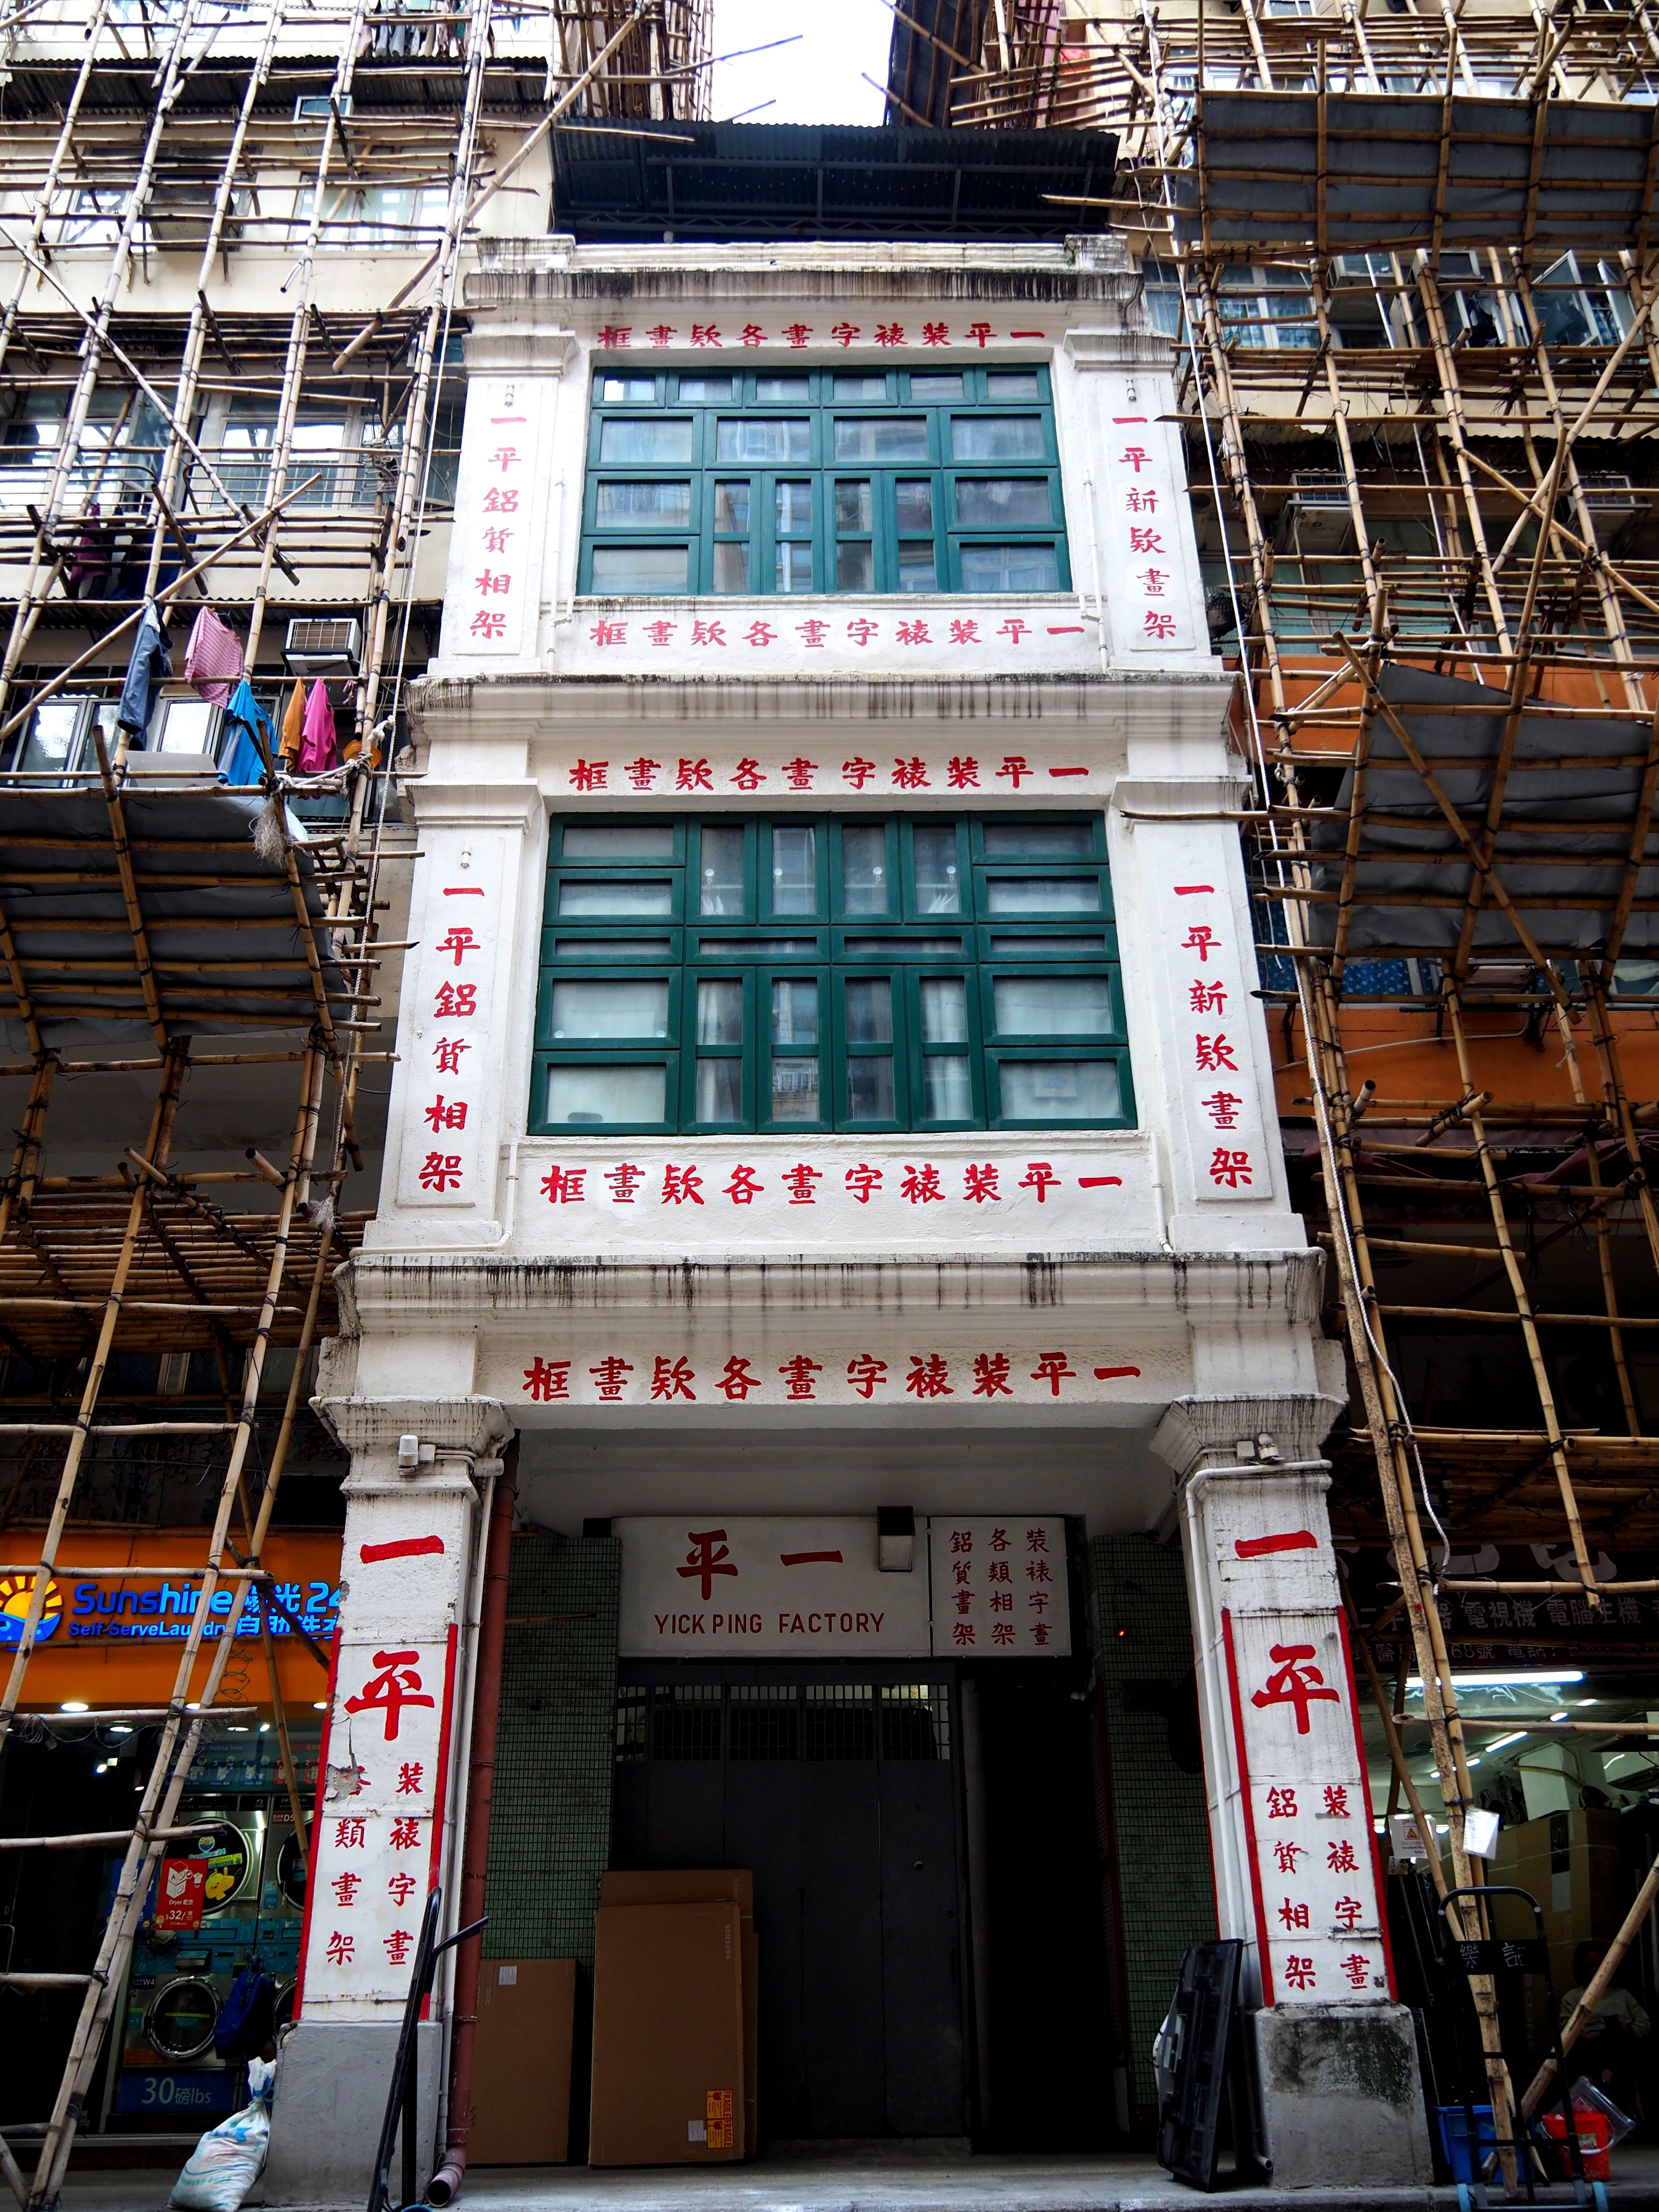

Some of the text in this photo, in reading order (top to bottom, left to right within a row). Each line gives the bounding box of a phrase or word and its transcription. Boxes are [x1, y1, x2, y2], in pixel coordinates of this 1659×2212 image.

[470, 417, 526, 639] 一平鋁質相架
[419, 887, 485, 1193] 一平鋁質相架
[72, 1583, 233, 1615] Sunshine
[654, 1612, 885, 1634] YICK PING FACTORY
[948, 1530, 976, 1646] 鋁質畫架
[988, 1528, 1016, 1646] 各類相架
[1025, 1528, 1054, 1646] 裝裱字畫
[1464, 1601, 1537, 1629] 電視機
[383, 1762, 424, 1966] 裝裱字畫
[1266, 1785, 1317, 1991] 鋁質相架
[1322, 1785, 1370, 1990] 裝裱字畫
[724, 2120, 732, 2147] FRAGILE
